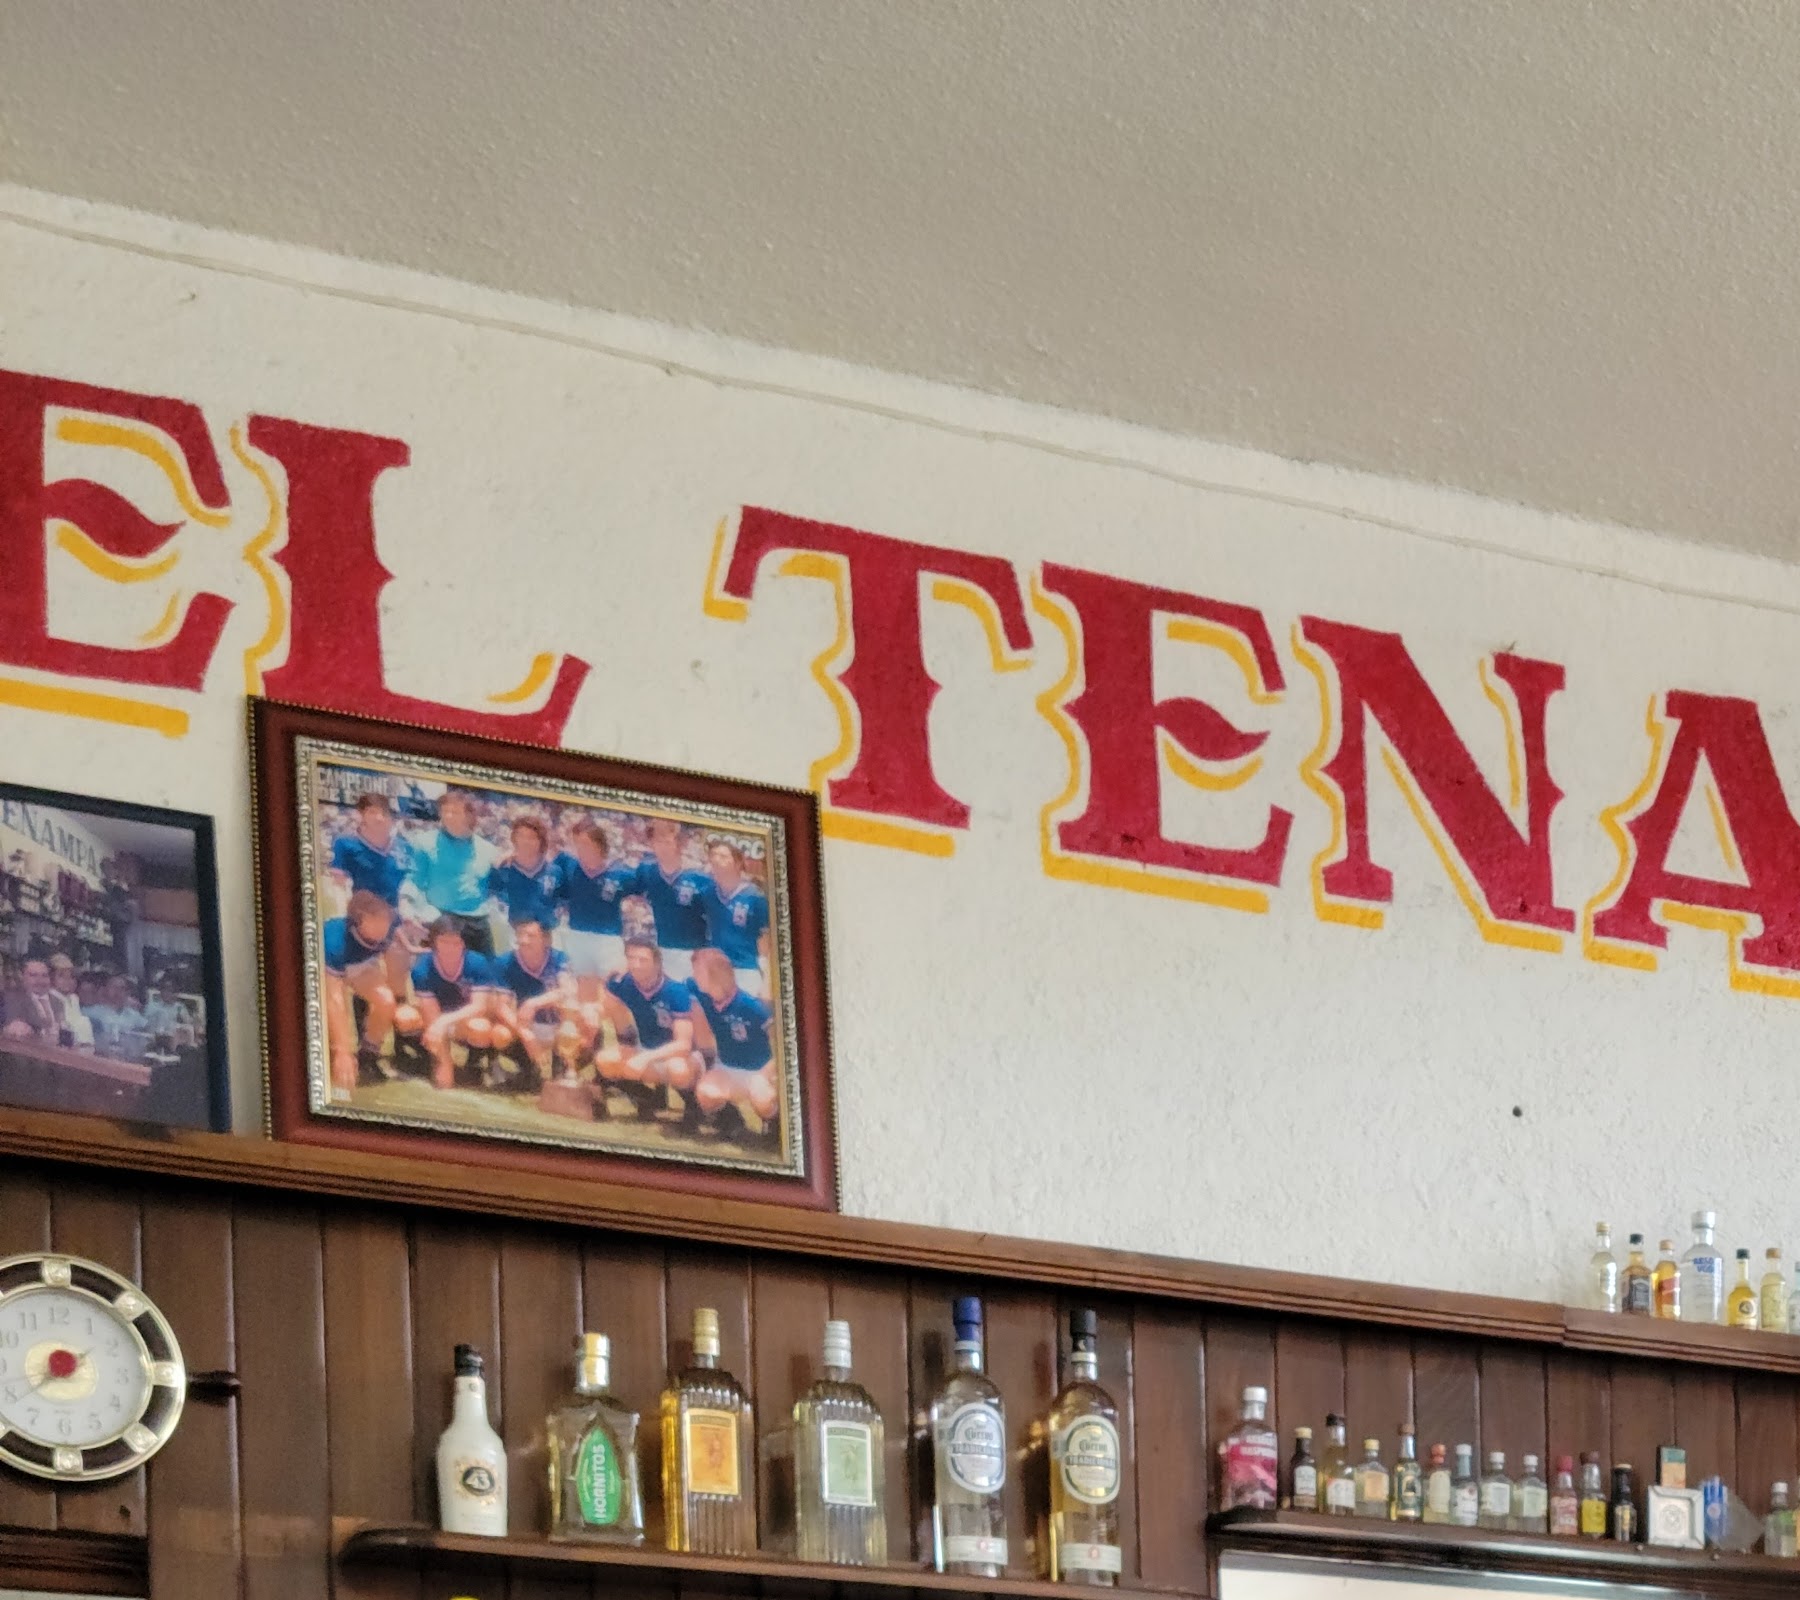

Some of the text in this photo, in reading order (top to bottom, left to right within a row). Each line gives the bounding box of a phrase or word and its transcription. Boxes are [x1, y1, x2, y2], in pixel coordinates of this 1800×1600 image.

[0, 368, 591, 750] EL
[19, 1311, 38, 1331] 11
[48, 1307, 70, 1326] 12
[591, 1443, 608, 1519] HORNITOS
